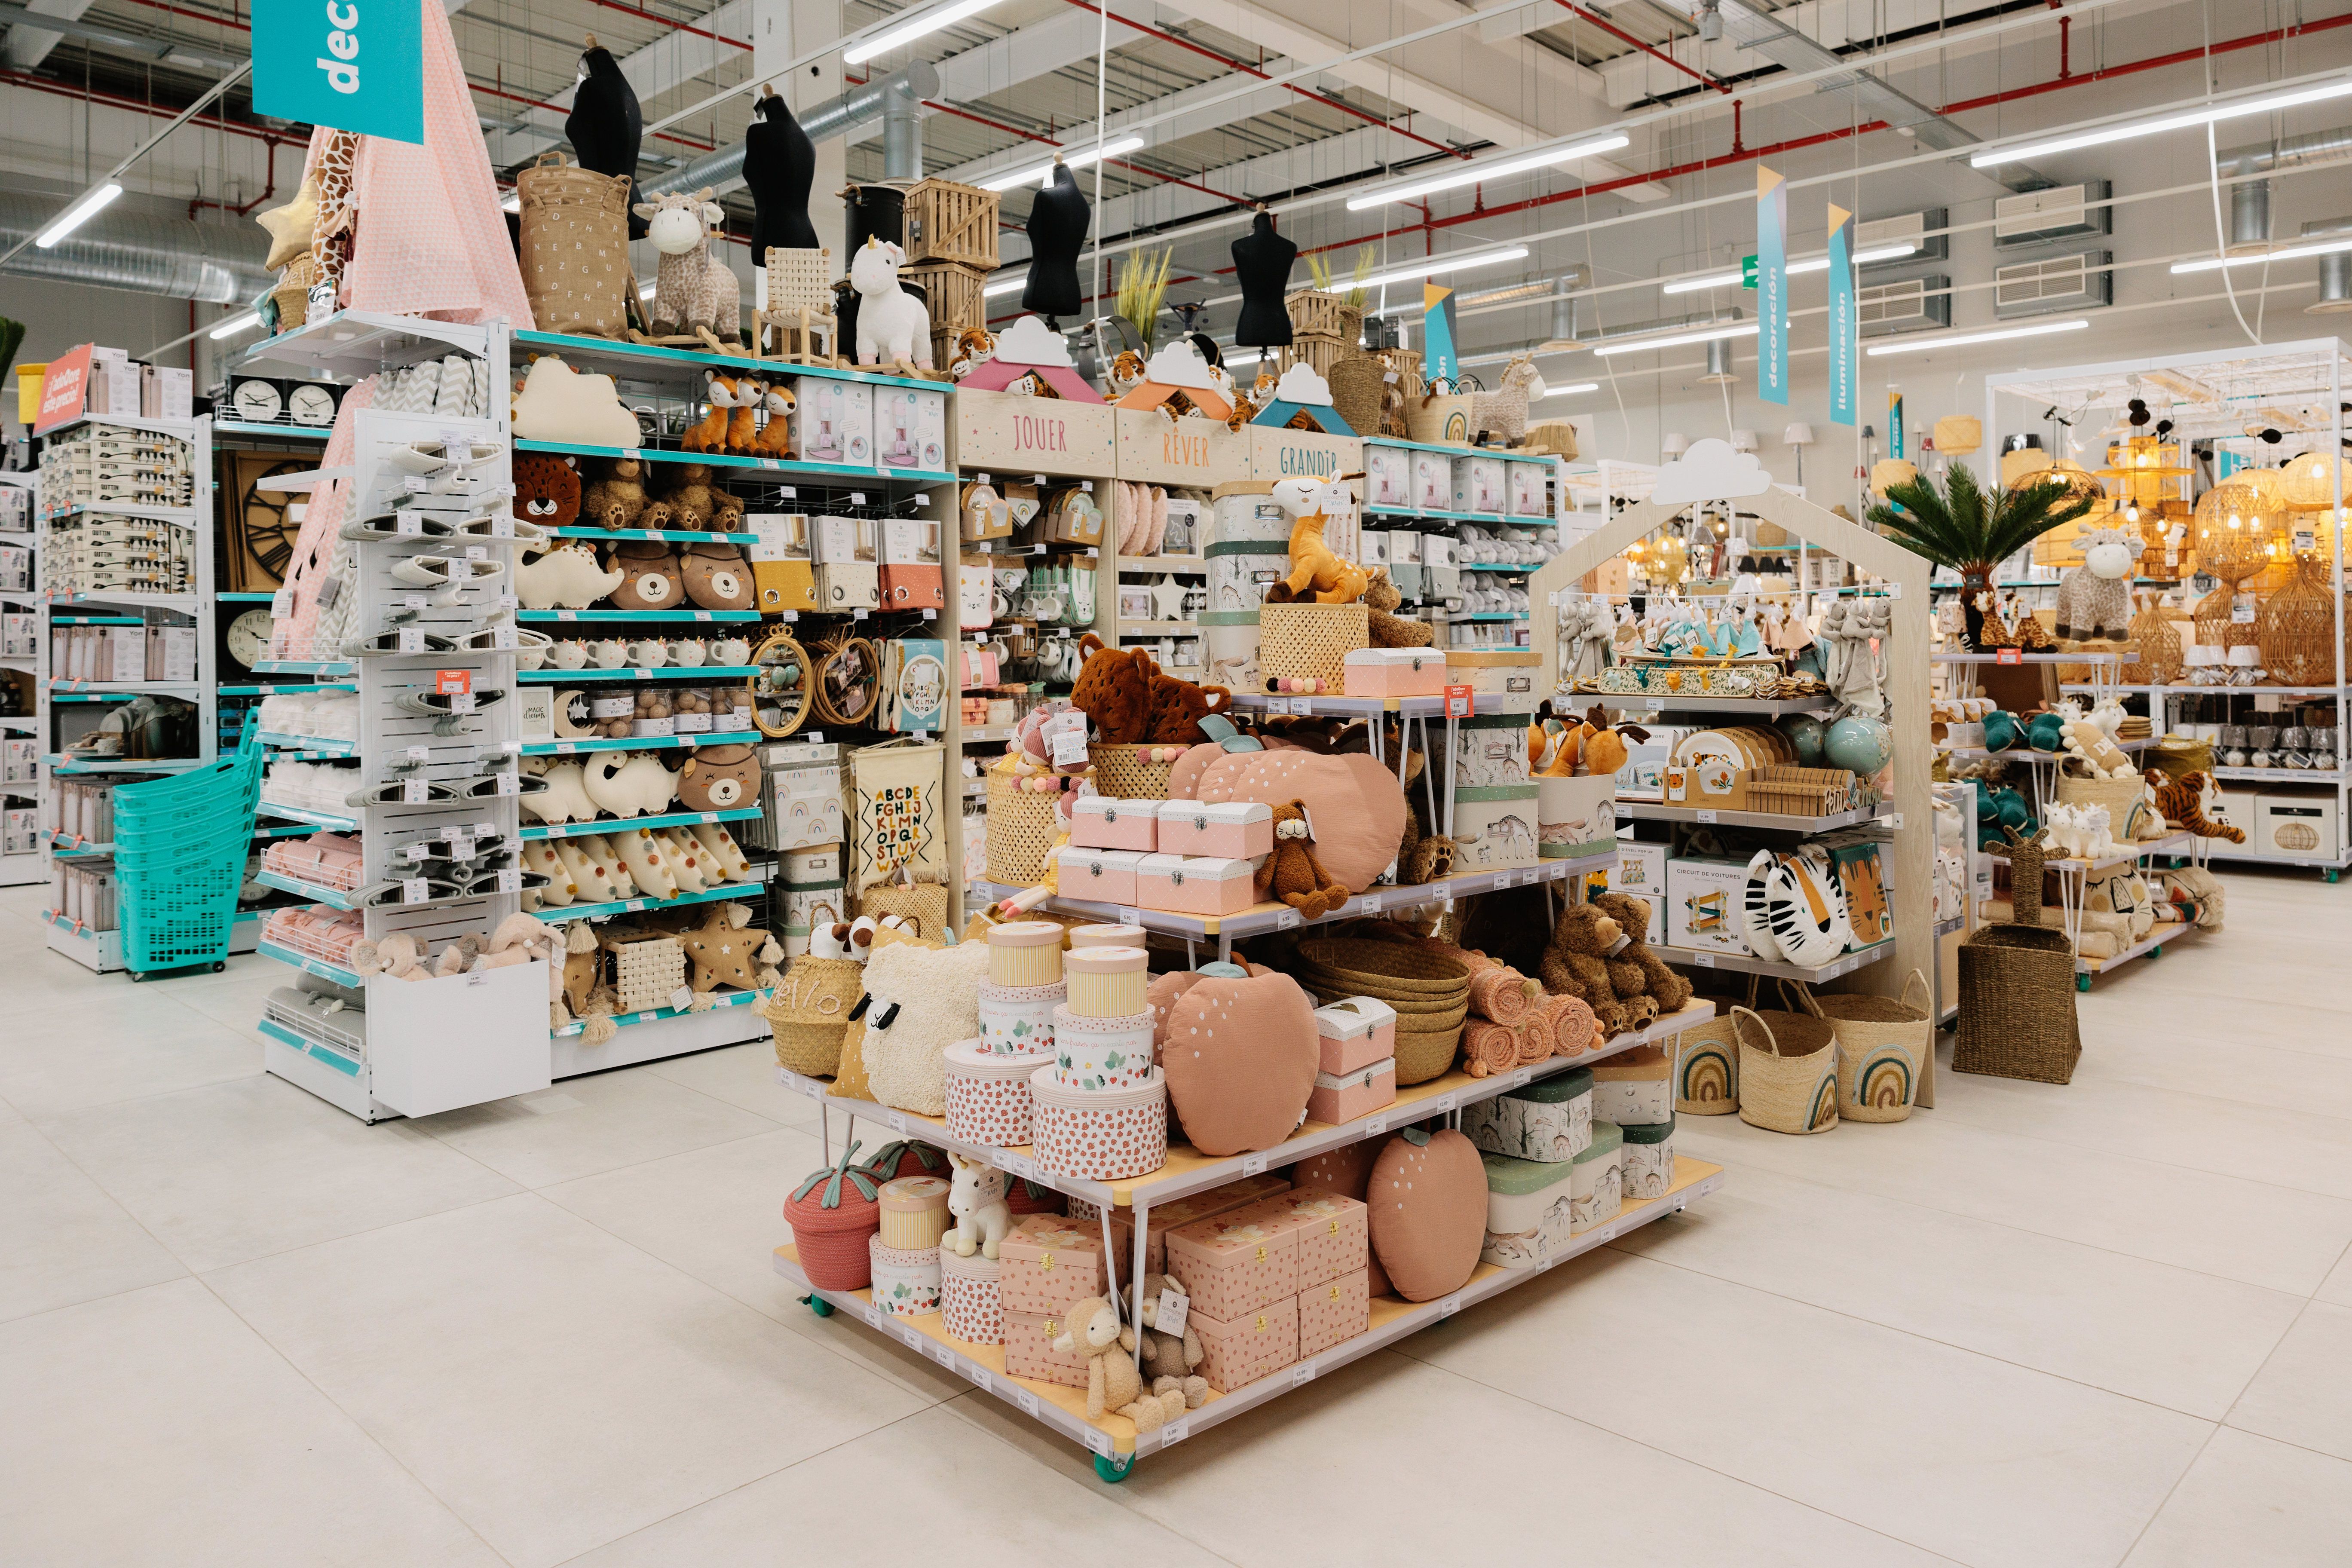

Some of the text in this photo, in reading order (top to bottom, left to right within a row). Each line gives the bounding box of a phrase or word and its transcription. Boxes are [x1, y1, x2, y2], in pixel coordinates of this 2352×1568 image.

[317, 0, 360, 94] dec
[1768, 267, 1777, 387] decoración
[1013, 416, 1067, 452] JOUER
[1164, 426, 1209, 467] RÊVER
[524, 710, 545, 720] dreams
[1733, 733, 1747, 742] REPAS
[1745, 732, 1758, 741] REPAS
[1824, 786, 1848, 817] Petit
[1711, 872, 1740, 880] VOITURES
[769, 977, 841, 1015] Hello
[1069, 1037, 1088, 1049] fraises
[1126, 1041, 1136, 1050] pas
[911, 1274, 923, 1283] pas
